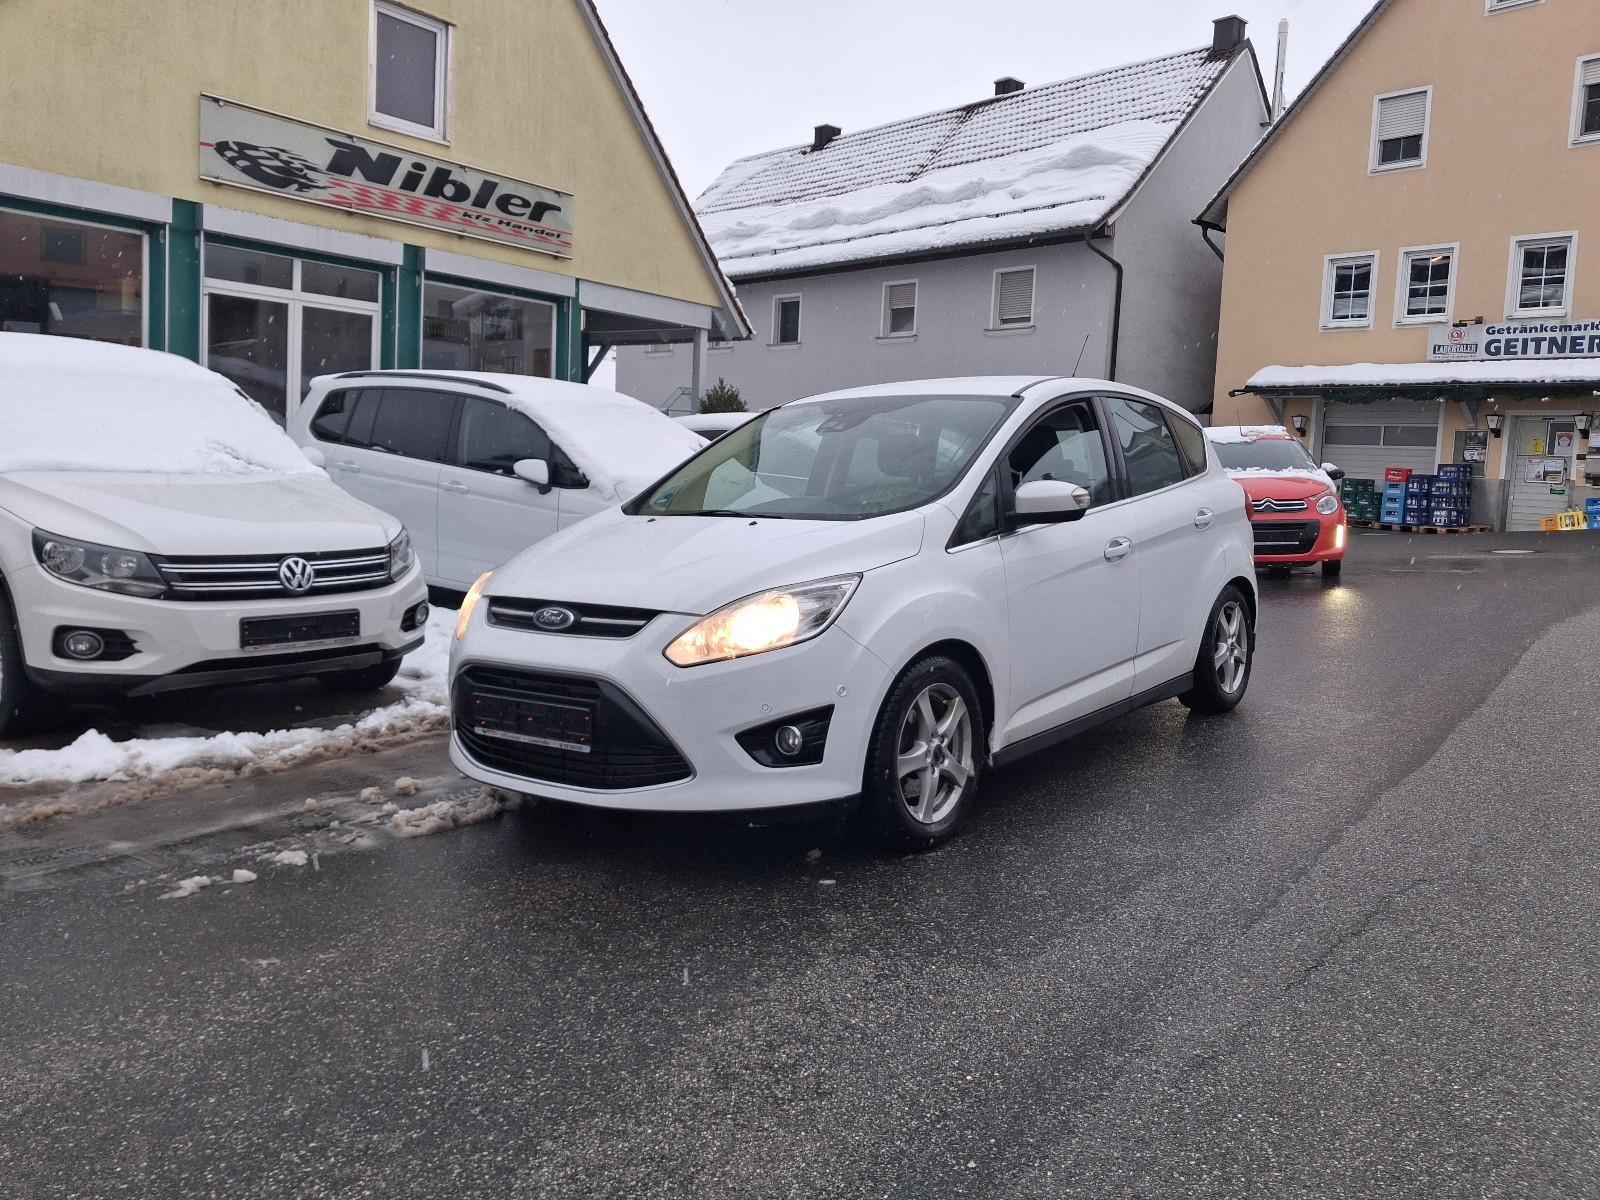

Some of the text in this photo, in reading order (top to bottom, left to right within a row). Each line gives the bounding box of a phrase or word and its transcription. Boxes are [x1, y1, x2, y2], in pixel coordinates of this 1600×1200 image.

[325, 137, 562, 223] Nibler
[497, 219, 562, 239] Handel
[1485, 321, 1600, 336] Getränkemark
[1484, 334, 1600, 357] GEITNER
[280, 557, 314, 591] VW
[538, 609, 565, 624] Ford
